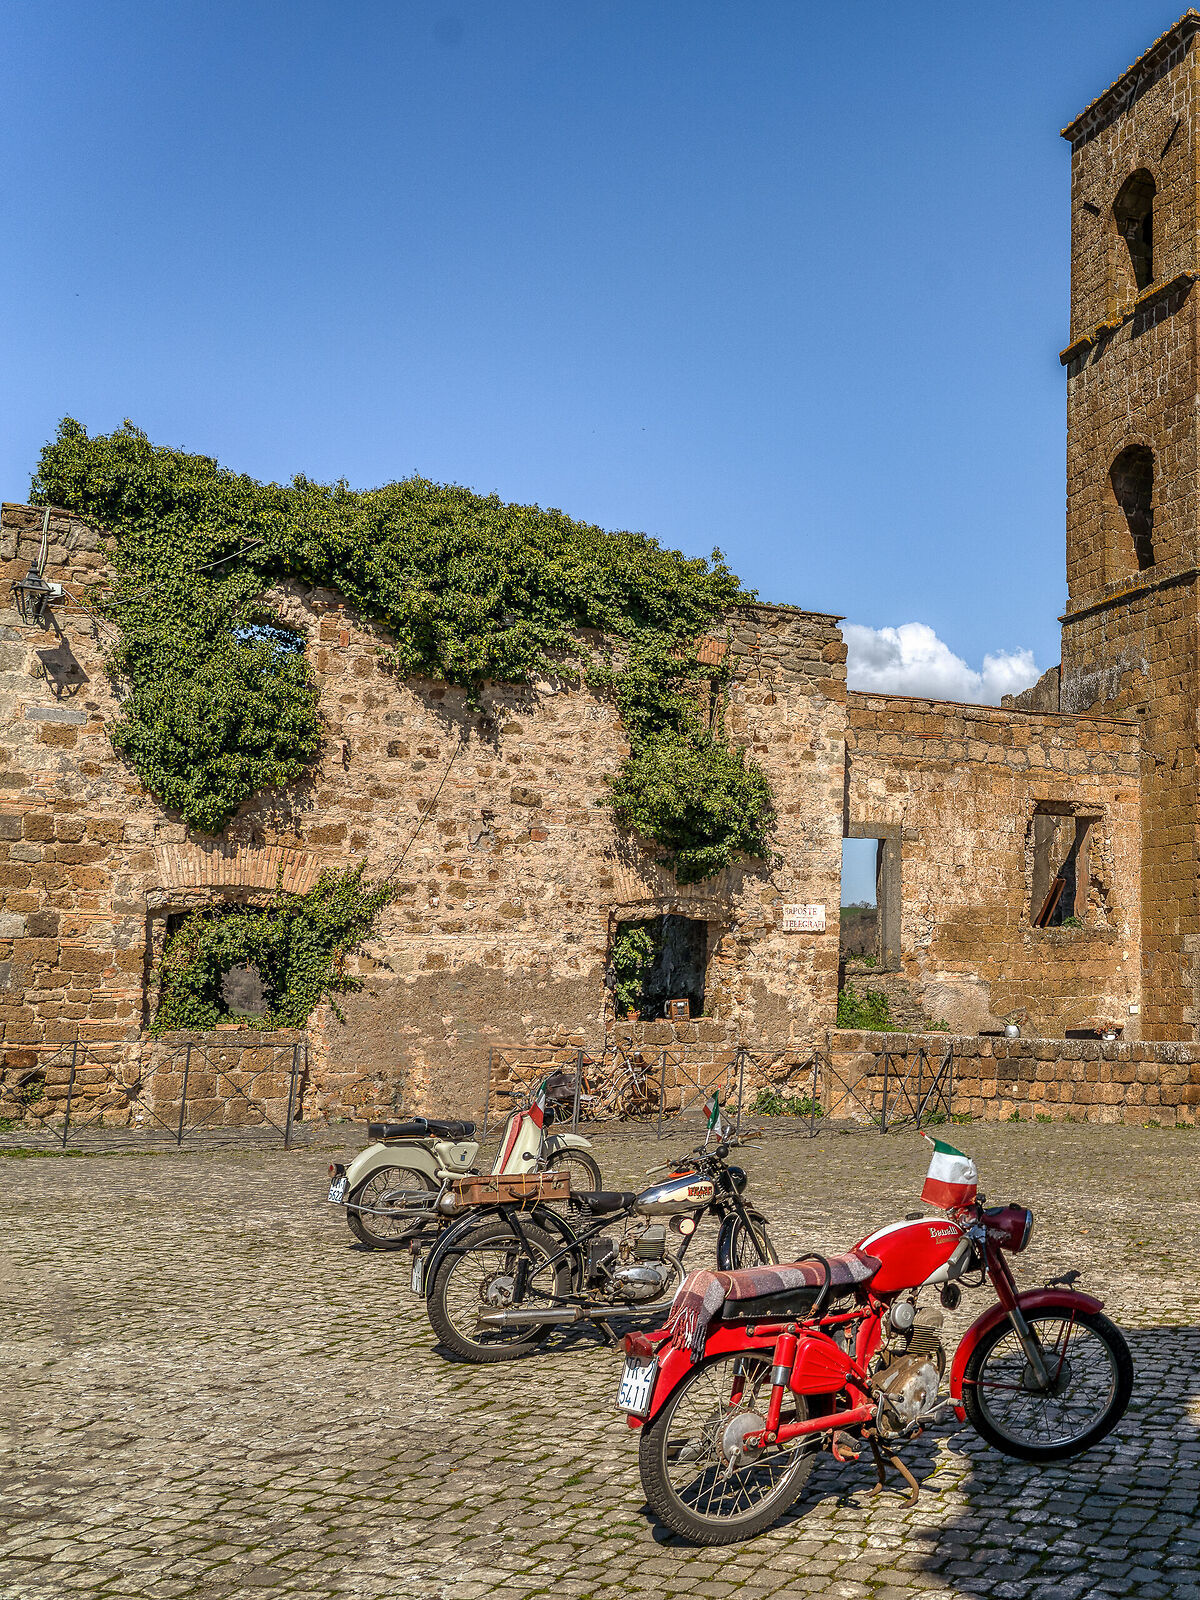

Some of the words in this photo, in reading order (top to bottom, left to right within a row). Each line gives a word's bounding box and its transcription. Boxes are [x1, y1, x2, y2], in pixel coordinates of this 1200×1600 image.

[785, 920, 824, 928] TELEGRAFI
[928, 1225, 959, 1238] Benelli
[619, 1383, 646, 1410] 5411
